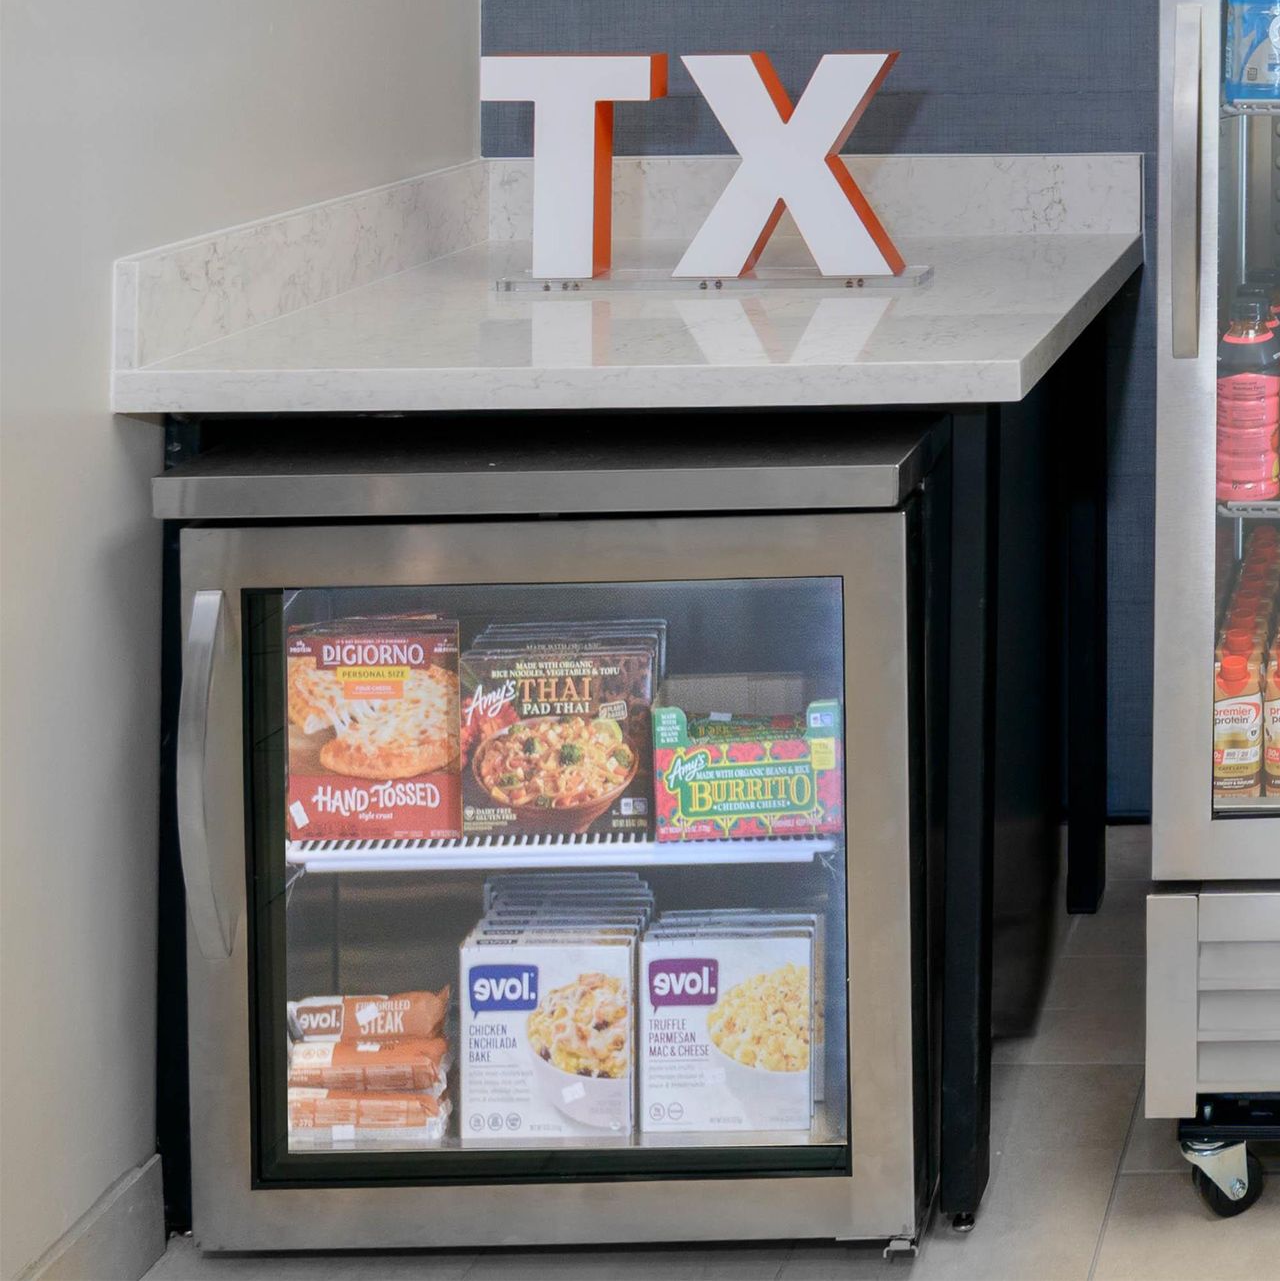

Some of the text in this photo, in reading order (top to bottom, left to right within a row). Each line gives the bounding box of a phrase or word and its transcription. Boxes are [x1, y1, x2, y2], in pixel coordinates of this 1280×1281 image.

[481, 51, 906, 279] TX
[342, 670, 405, 679] PERSONAL SIZE
[518, 677, 592, 703] THAI
[465, 680, 517, 726] Amy's
[522, 702, 590, 715] PAD THAI
[668, 754, 707, 788] Amy's
[312, 780, 440, 817] HAND-TOSSED
[689, 774, 811, 812] BURRITO
[717, 801, 756, 811] CHEDDAR
[473, 972, 536, 1002] evol.
[653, 966, 716, 996] evol.
[300, 1009, 341, 1030] evol.
[649, 1019, 687, 1030] TRUFFLE
[469, 1024, 507, 1036] CHICKEN
[649, 1032, 696, 1043] PARMESAN
[469, 1037, 518, 1049] ENCHILADA
[649, 1045, 710, 1057] MAC CHEESE
[469, 1051, 492, 1063] BAKE
